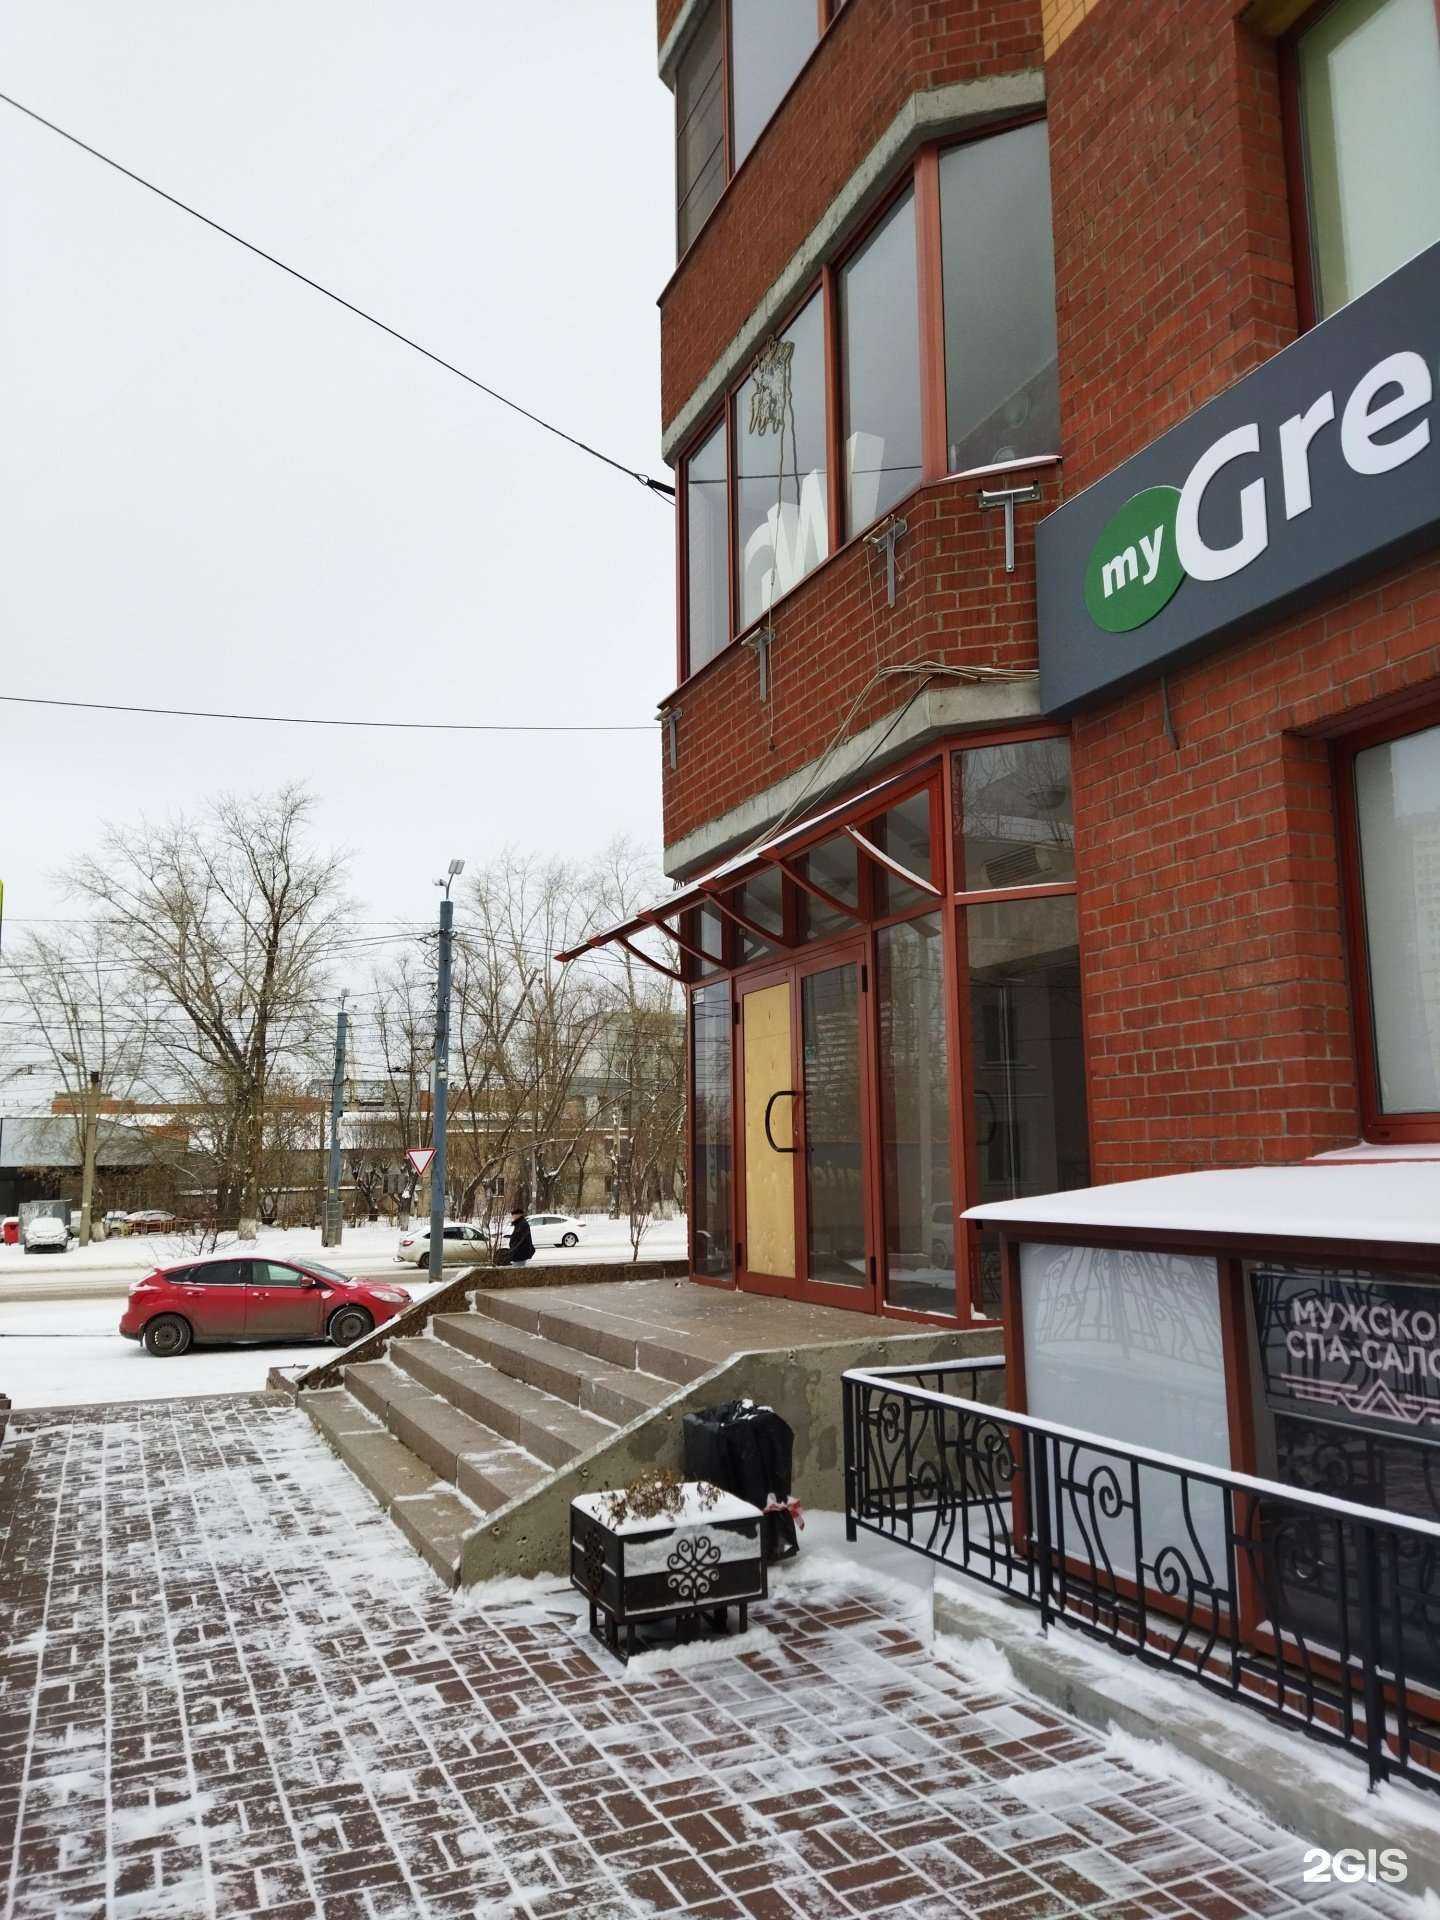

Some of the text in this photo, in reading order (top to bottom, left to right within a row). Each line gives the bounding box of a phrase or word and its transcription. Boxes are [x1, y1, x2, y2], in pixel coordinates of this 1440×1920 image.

[1101, 351, 1433, 599] my Gre
[1293, 1297, 1440, 1342] МУЖСКО
